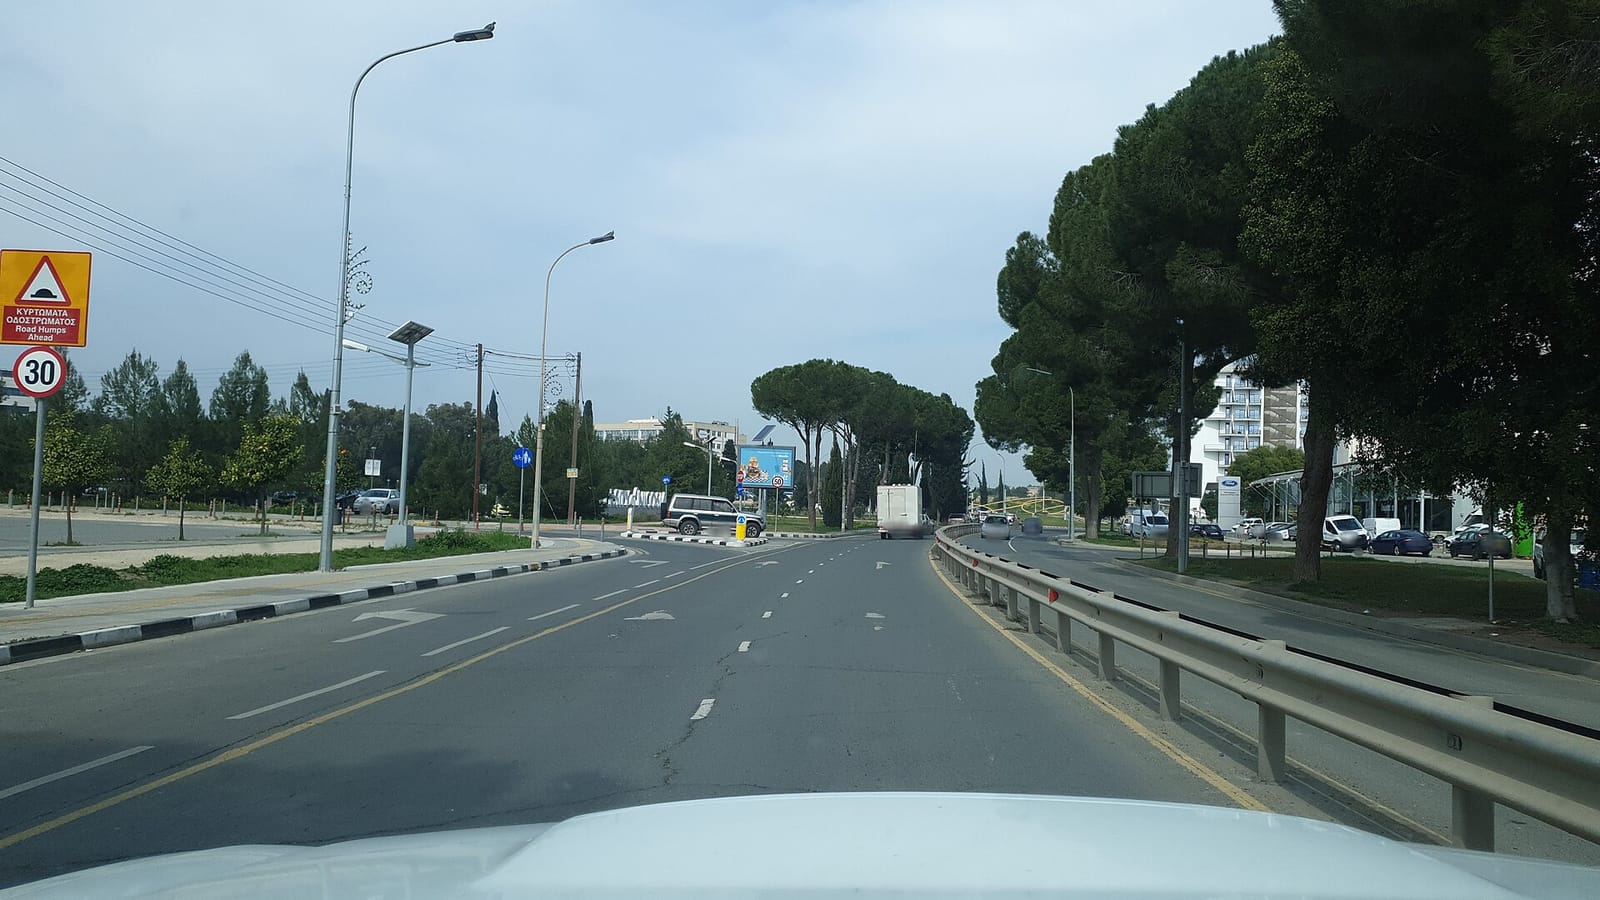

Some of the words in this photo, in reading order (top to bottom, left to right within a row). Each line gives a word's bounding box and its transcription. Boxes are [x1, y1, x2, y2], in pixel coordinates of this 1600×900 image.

[16, 308, 68, 317] ΚΥΡΤΩΜΑΤΑ
[6, 316, 76, 325] ΟΔΟΣΤΡΩΜΑΤΟΣ
[15, 325, 37, 333] Road
[38, 326, 67, 335] Humps
[24, 360, 55, 386] 30
[774, 478, 782, 487] 50
